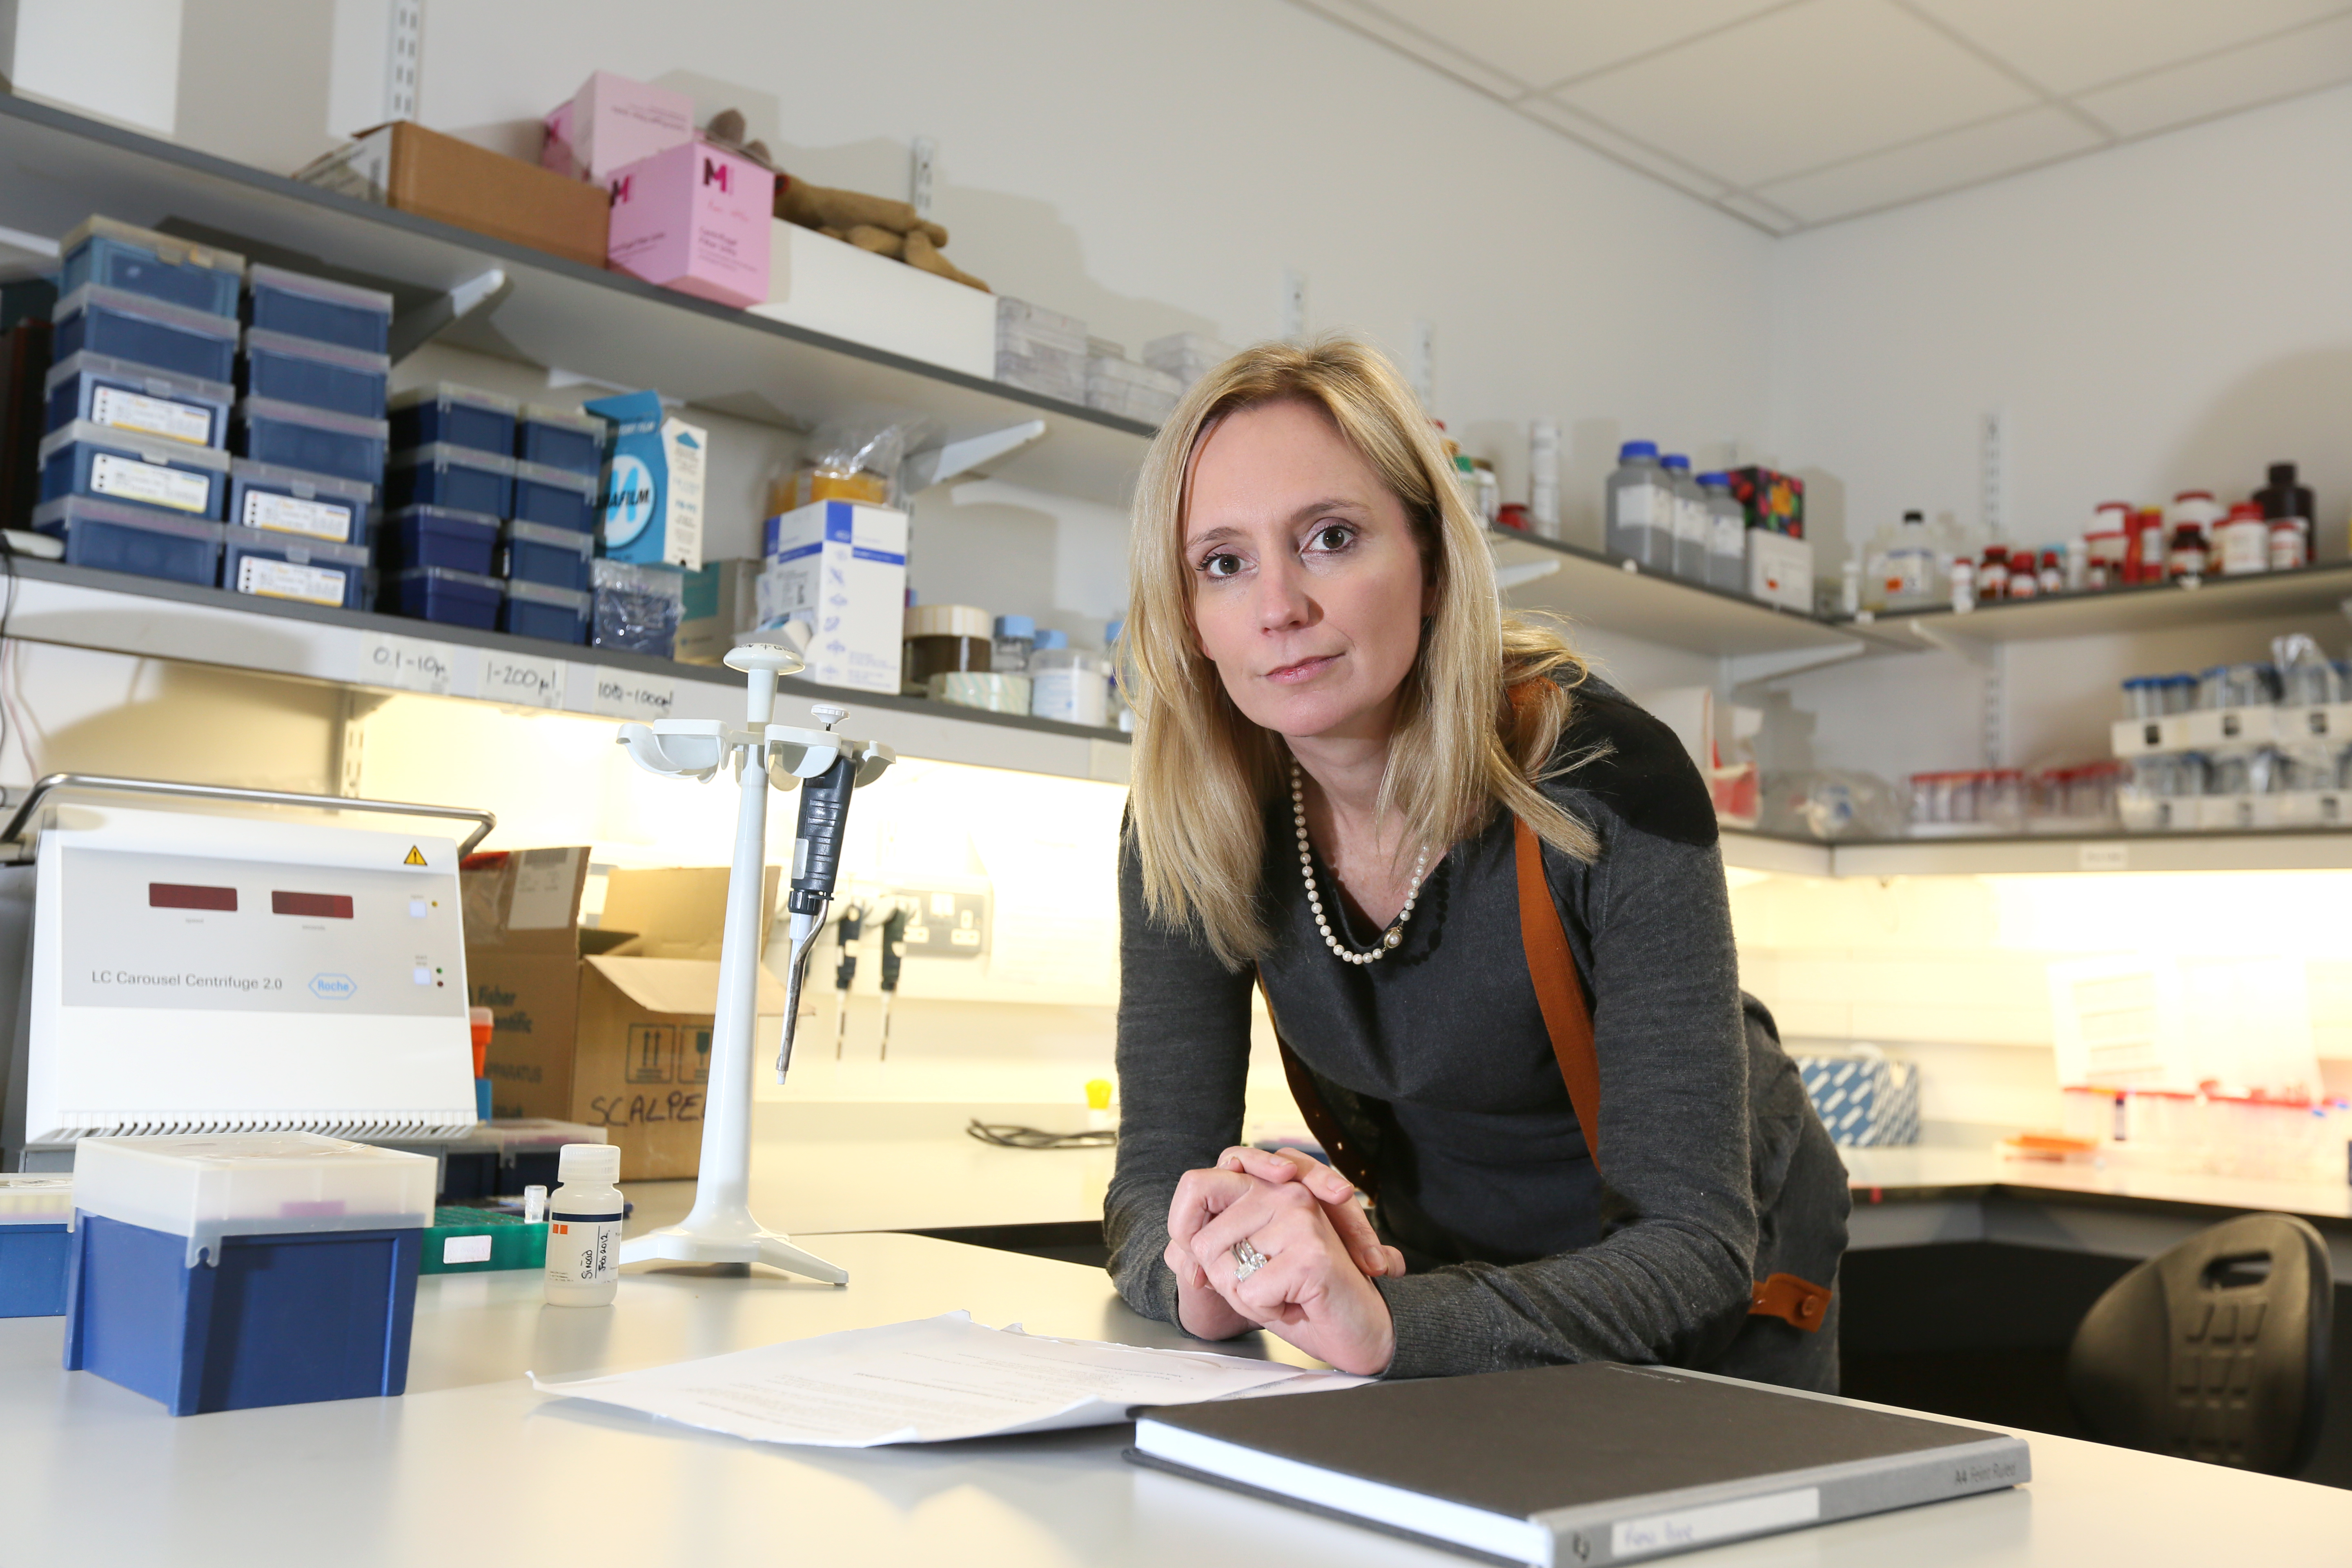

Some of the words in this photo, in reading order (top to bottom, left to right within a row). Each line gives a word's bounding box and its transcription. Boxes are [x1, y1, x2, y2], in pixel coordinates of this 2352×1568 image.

[91, 970, 111, 984] LC
[116, 971, 180, 986] Carousel
[185, 973, 259, 992] Centrifuge
[263, 976, 283, 991] 2.0
[318, 978, 350, 991] Roche
[587, 1090, 706, 1127] SCALPE
